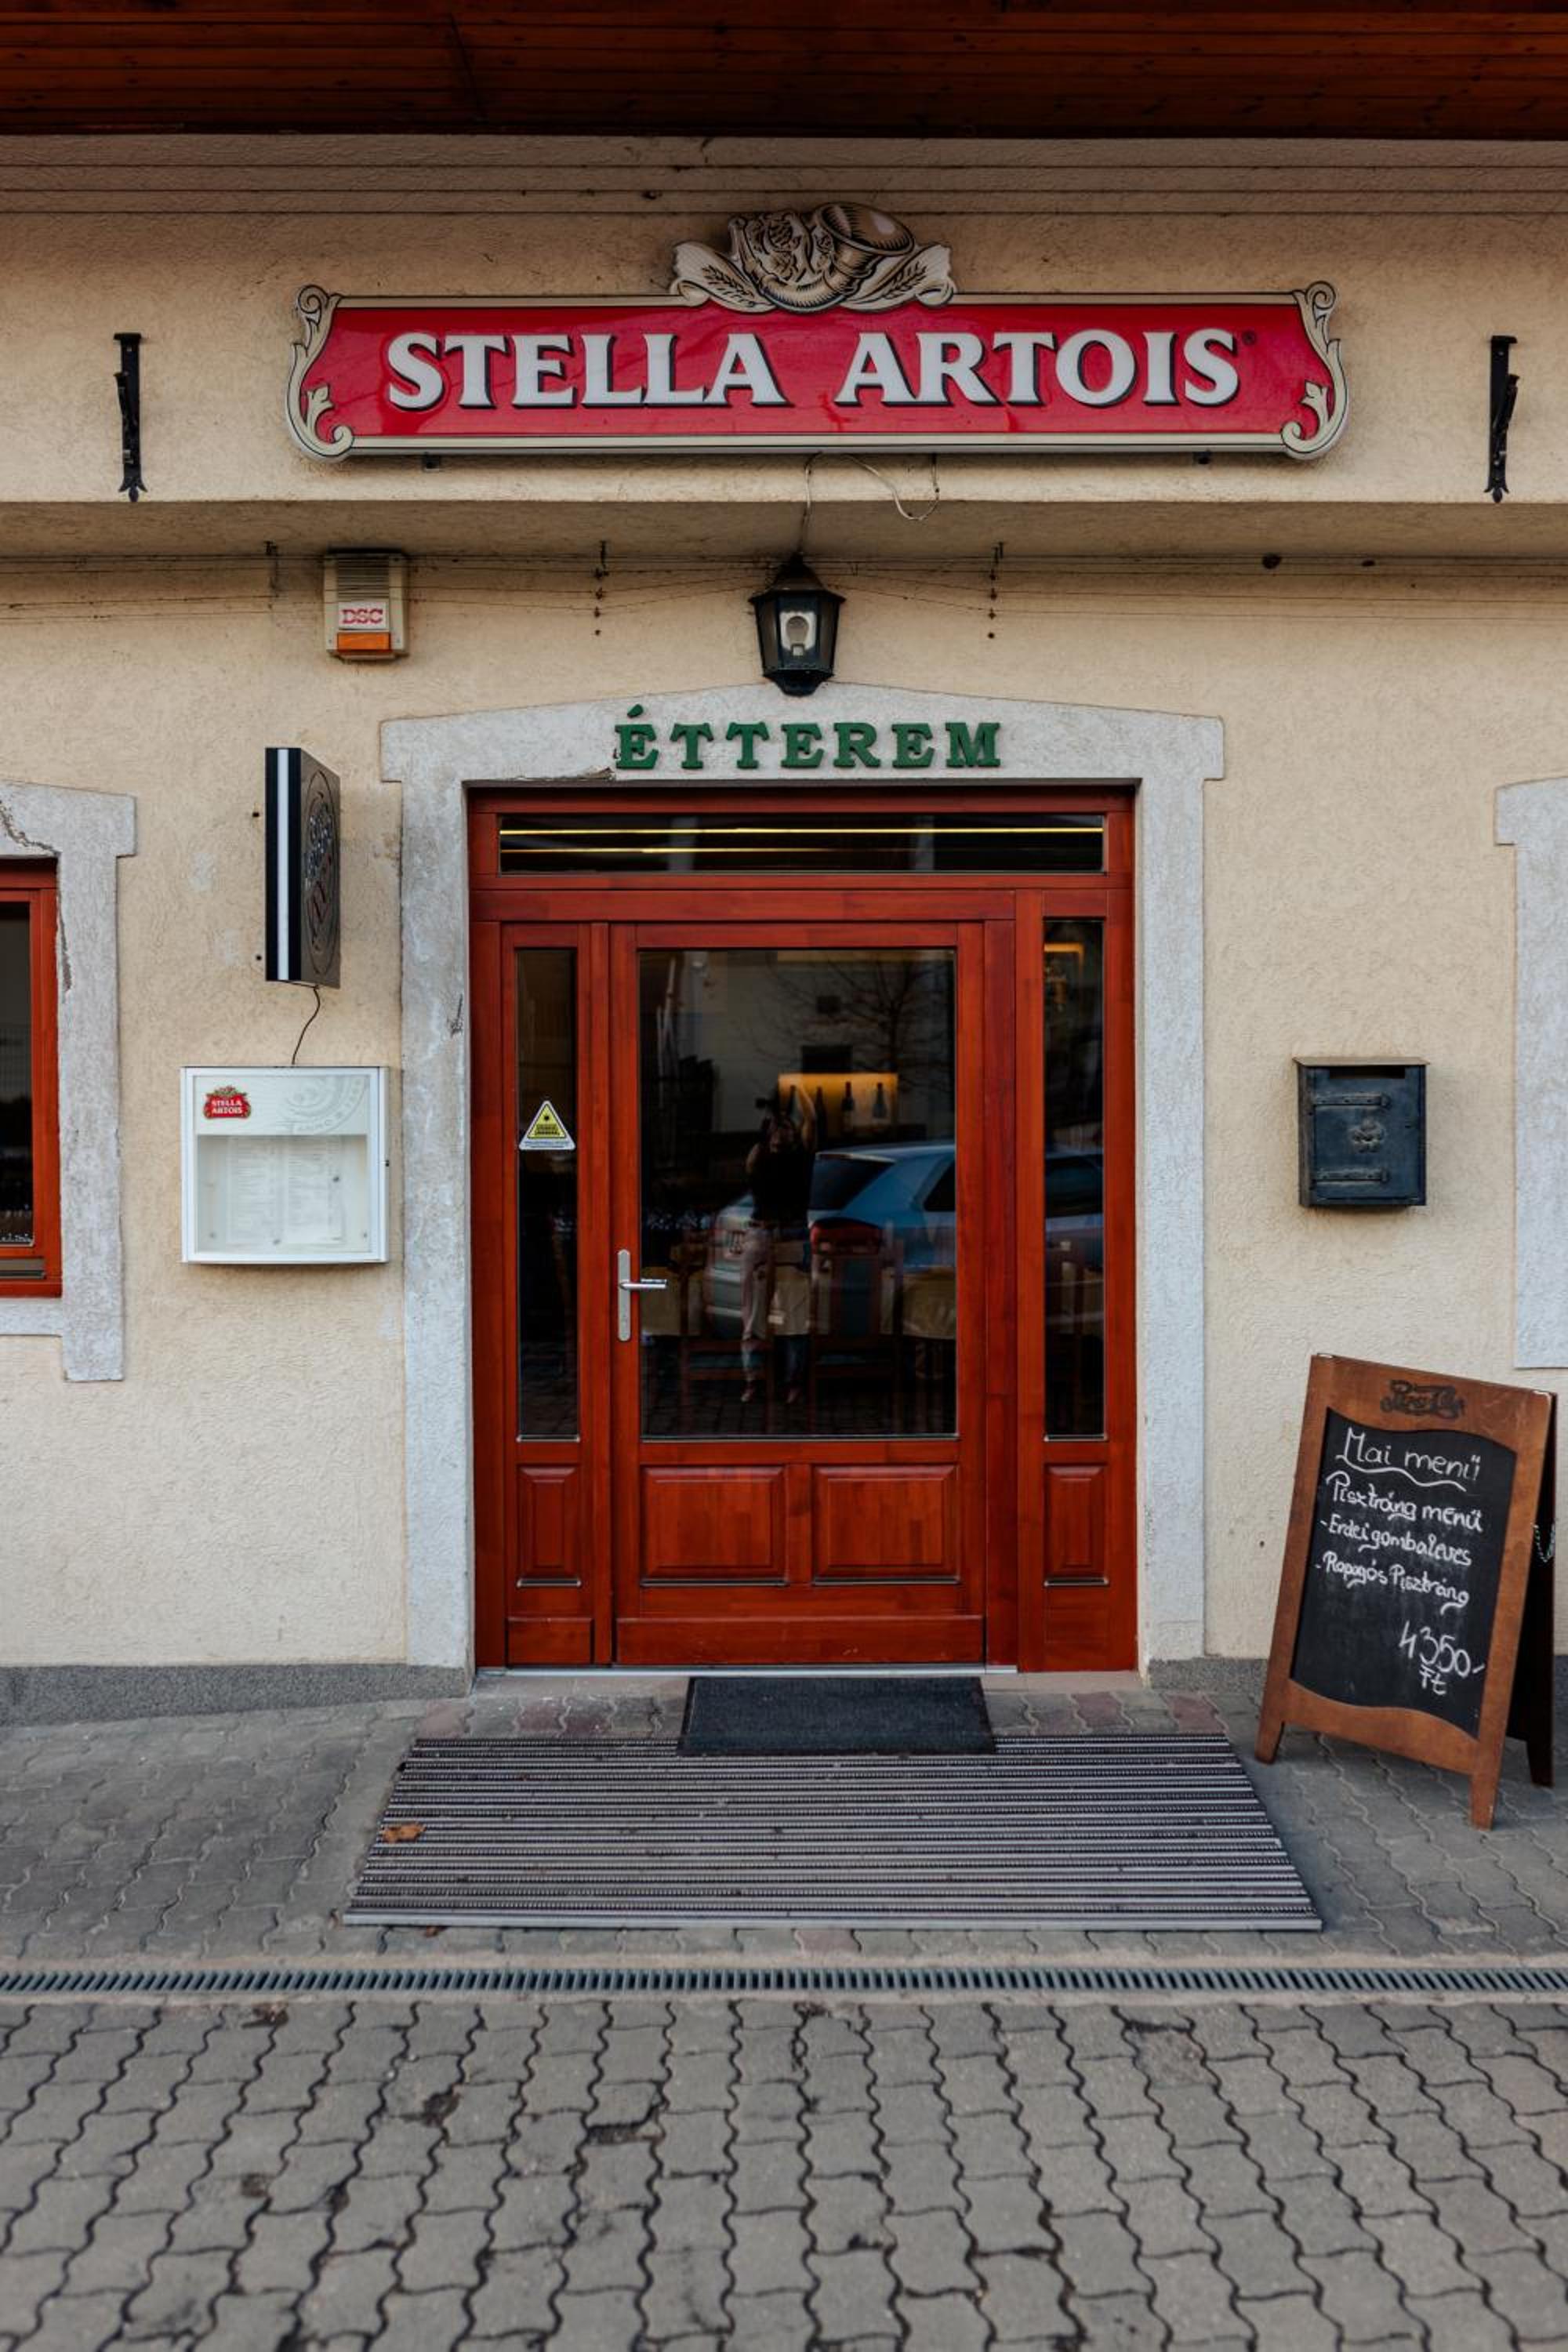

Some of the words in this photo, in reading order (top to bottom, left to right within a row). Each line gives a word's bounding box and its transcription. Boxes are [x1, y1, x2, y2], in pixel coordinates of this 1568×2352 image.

[387, 332, 794, 410] STELLA
[833, 328, 1241, 407] ARTOIS
[615, 704, 1001, 770] ÉTTEREM
[1344, 1427, 1392, 1465] Mai
[1404, 1451, 1481, 1481] menü
[1326, 1470, 1417, 1521] Pisztráng
[1358, 1530, 1472, 1566] gombaleves
[1420, 1664, 1446, 1695] Ft
